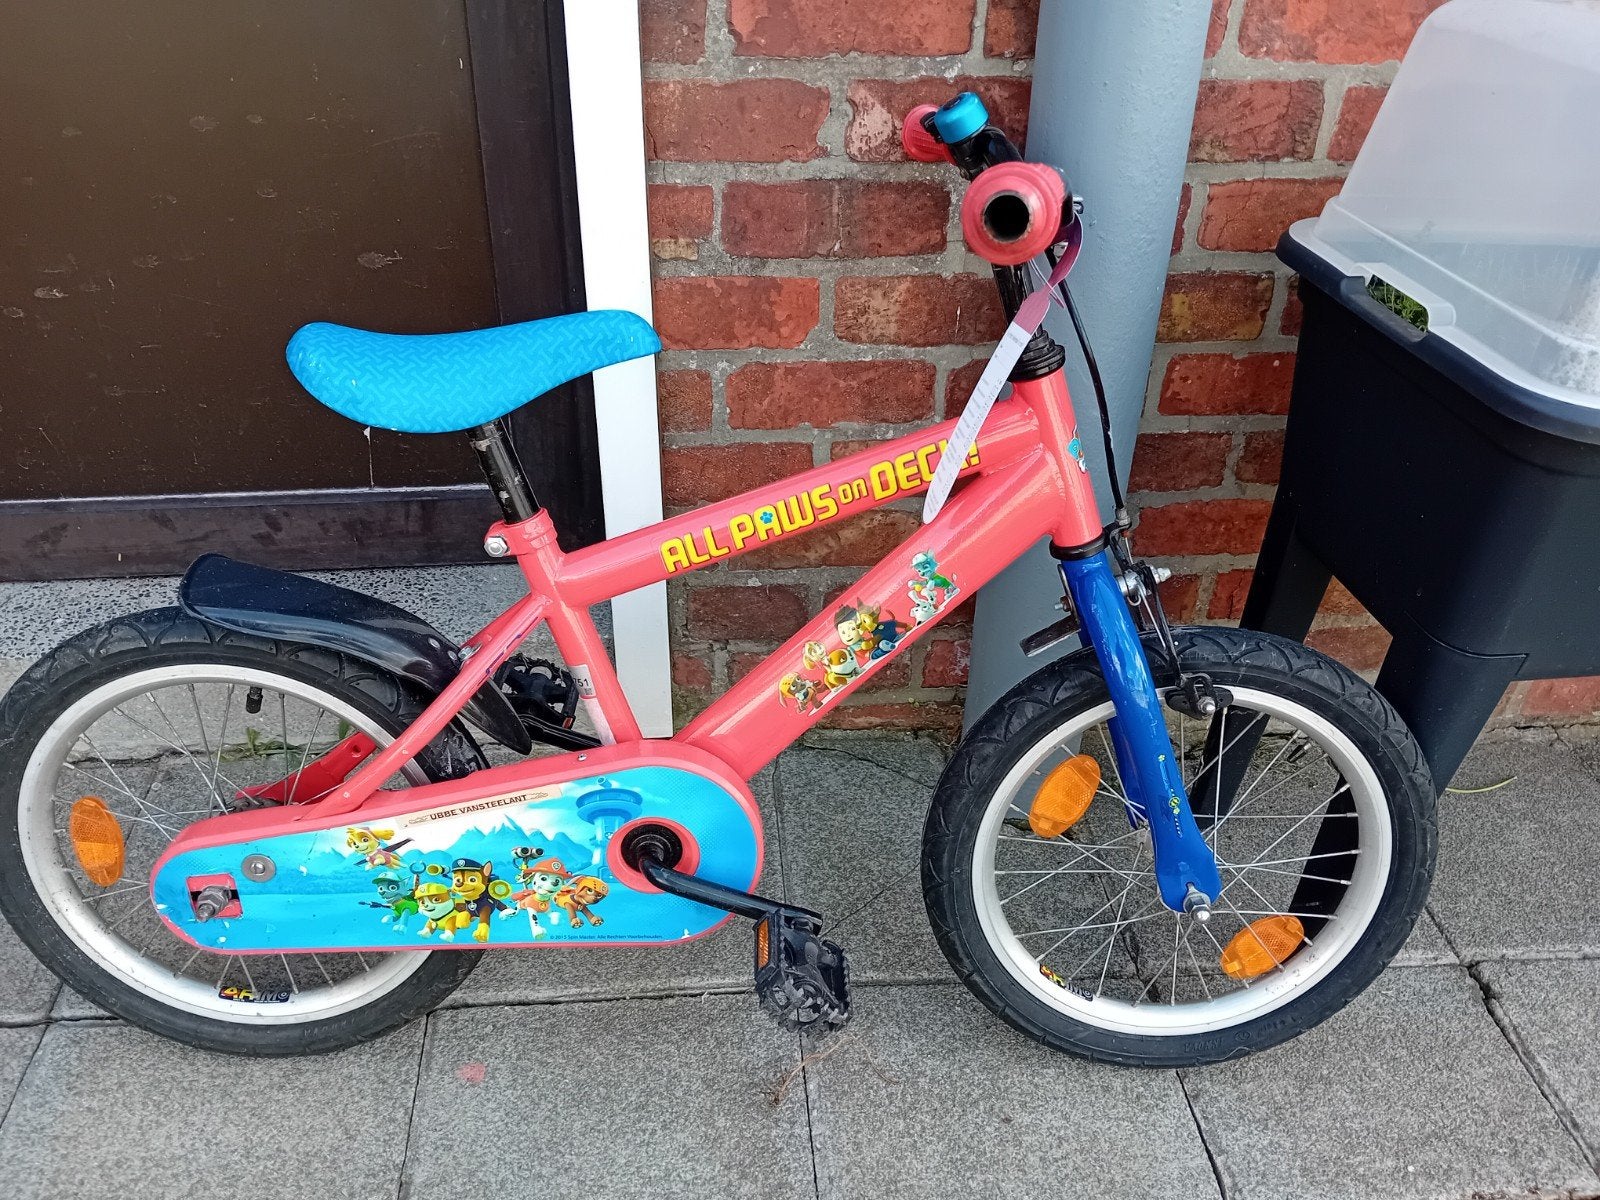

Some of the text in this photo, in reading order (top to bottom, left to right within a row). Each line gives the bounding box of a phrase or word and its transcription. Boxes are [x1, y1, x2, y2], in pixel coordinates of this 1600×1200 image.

[660, 526, 730, 573] ALL
[729, 483, 839, 550] PAWS
[838, 477, 868, 505] on
[430, 794, 528, 821] UBBE VANSTEELANT
